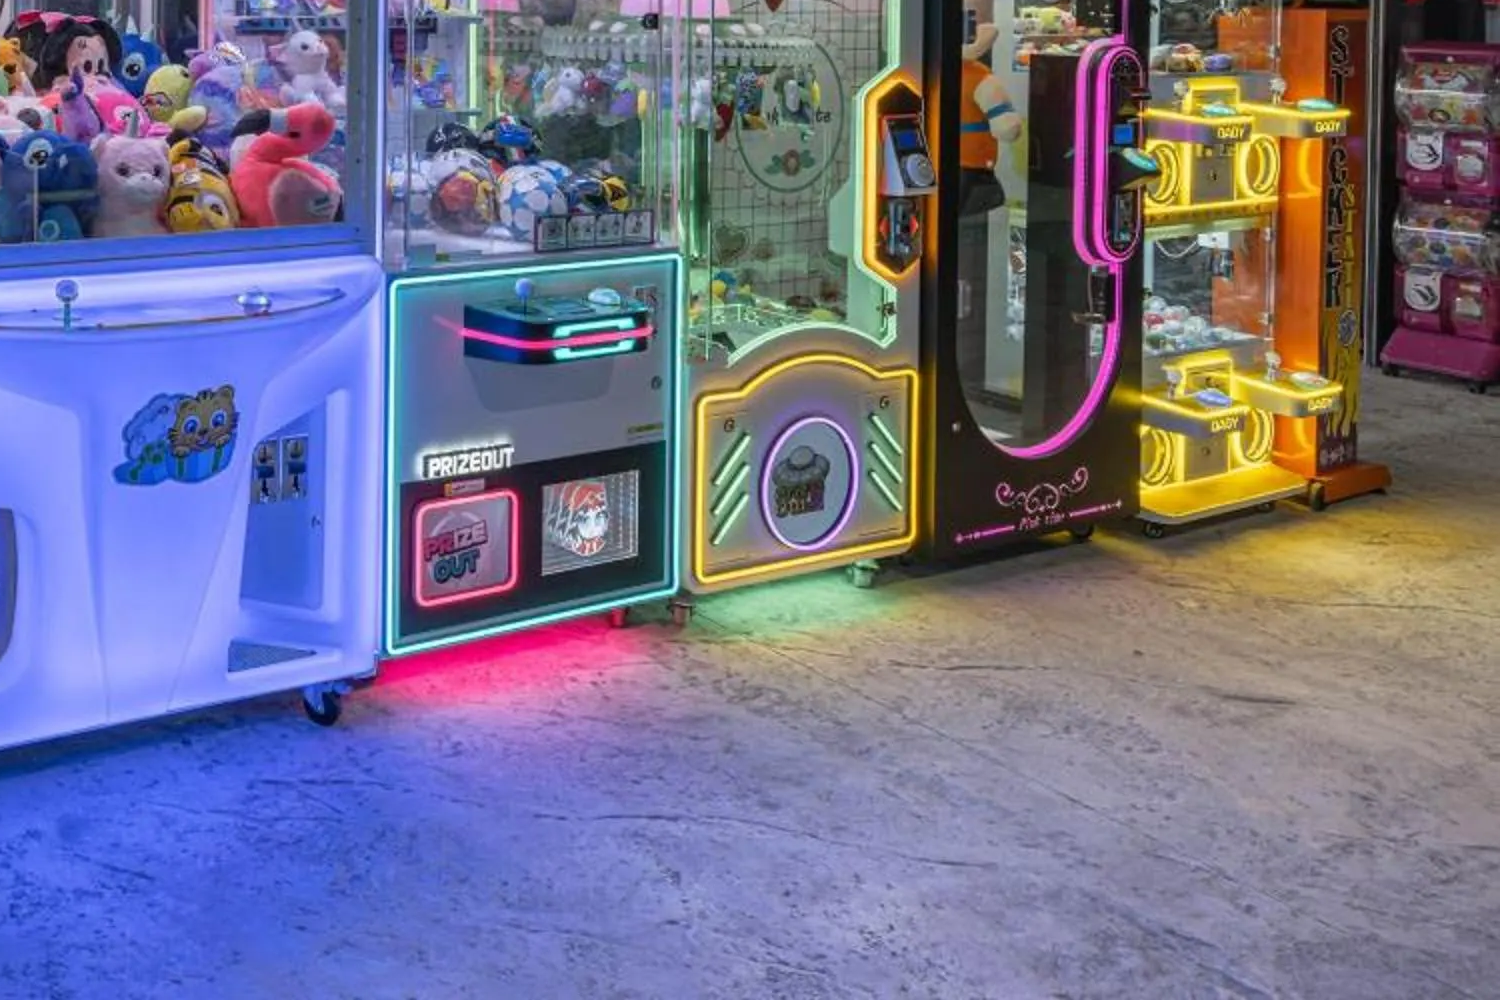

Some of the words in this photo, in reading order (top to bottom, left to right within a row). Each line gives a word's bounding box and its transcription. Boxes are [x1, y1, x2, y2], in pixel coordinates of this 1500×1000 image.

[1324, 24, 1354, 309] STCKER
[428, 447, 515, 478] PRIZEOUT
[423, 519, 488, 562] PRIZE
[434, 548, 480, 584] OUT
